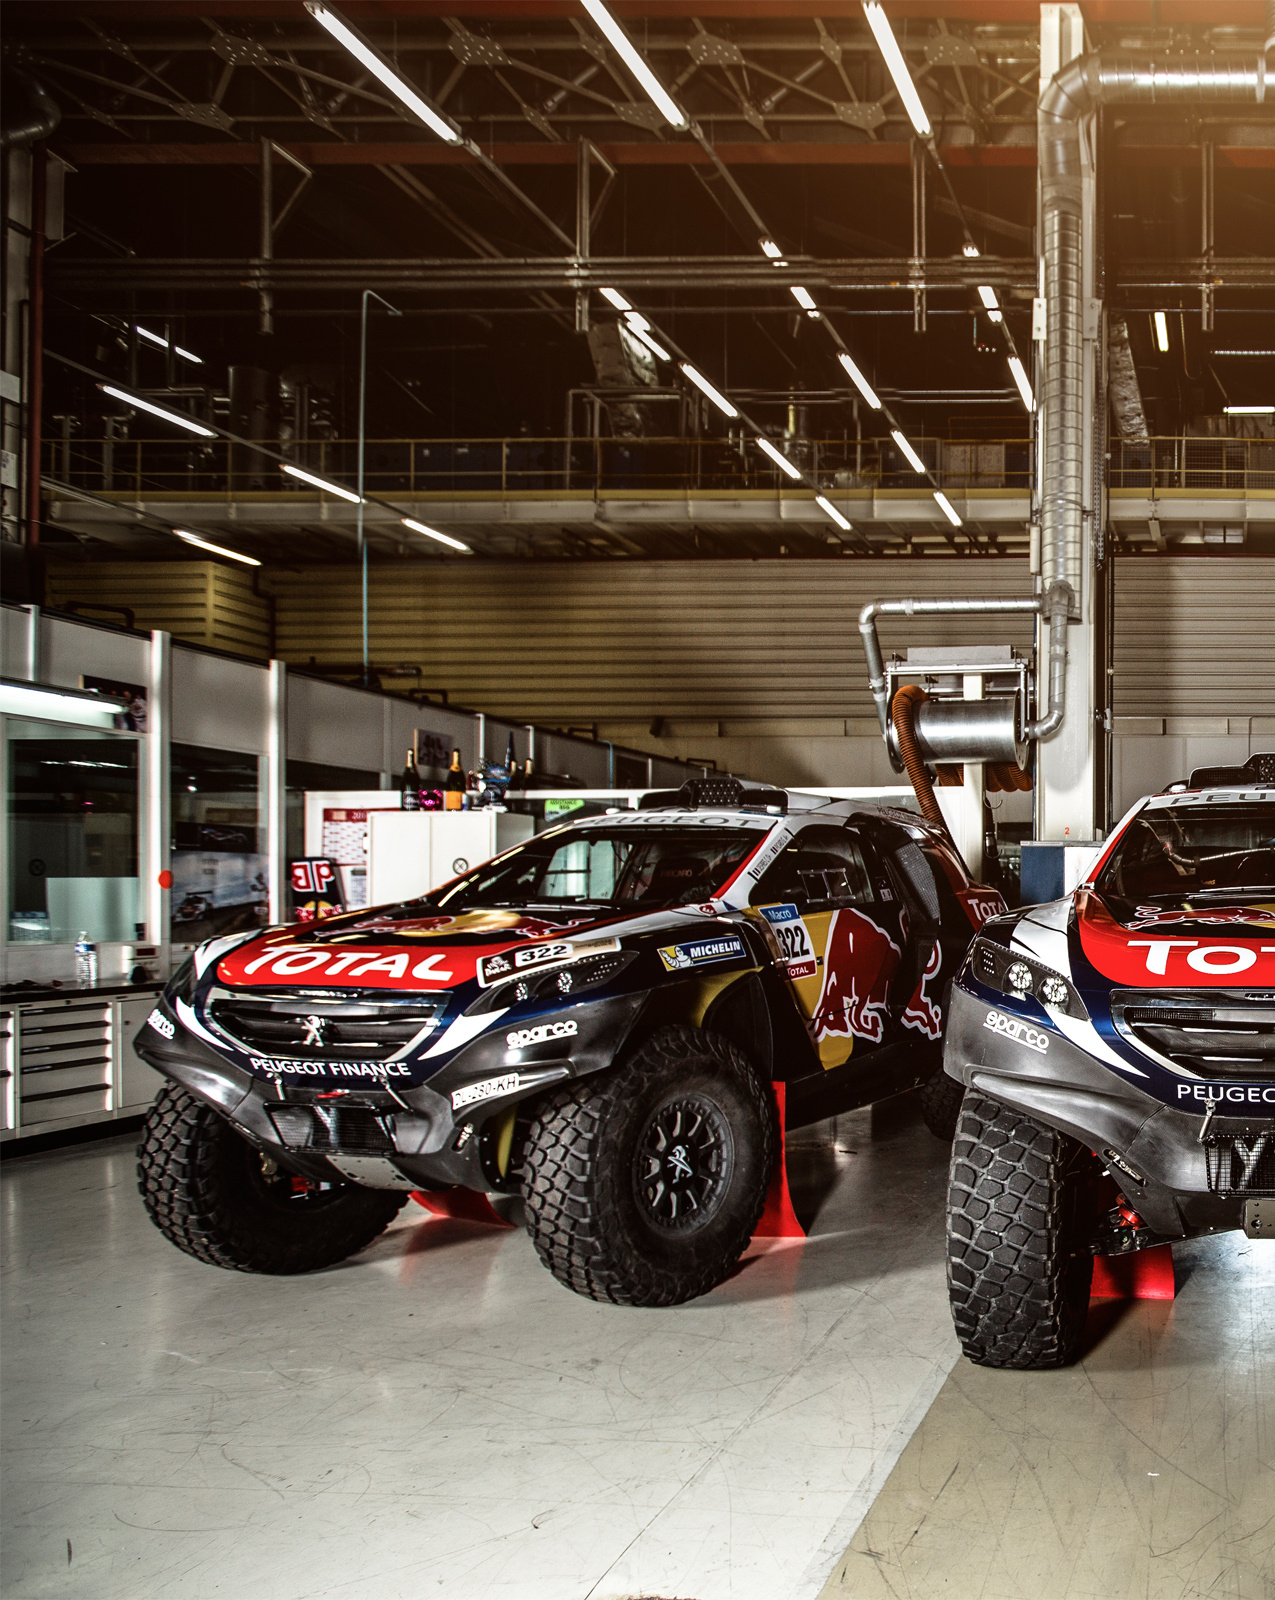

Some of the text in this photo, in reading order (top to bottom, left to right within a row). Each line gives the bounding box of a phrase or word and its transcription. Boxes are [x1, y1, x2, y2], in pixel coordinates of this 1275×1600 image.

[1063, 826, 1071, 835] 2
[768, 909, 791, 920] Macro
[967, 898, 1007, 921] TOTA
[690, 941, 740, 957] MICHELIN
[776, 925, 810, 958] 322
[521, 945, 568, 962] 322
[244, 946, 453, 981] TOTAL
[787, 966, 809, 977] TOTAL
[506, 1020, 577, 1048] sparco
[985, 1010, 1049, 1051] sparco
[250, 1058, 411, 1077] PEUGEOT FINANCE
